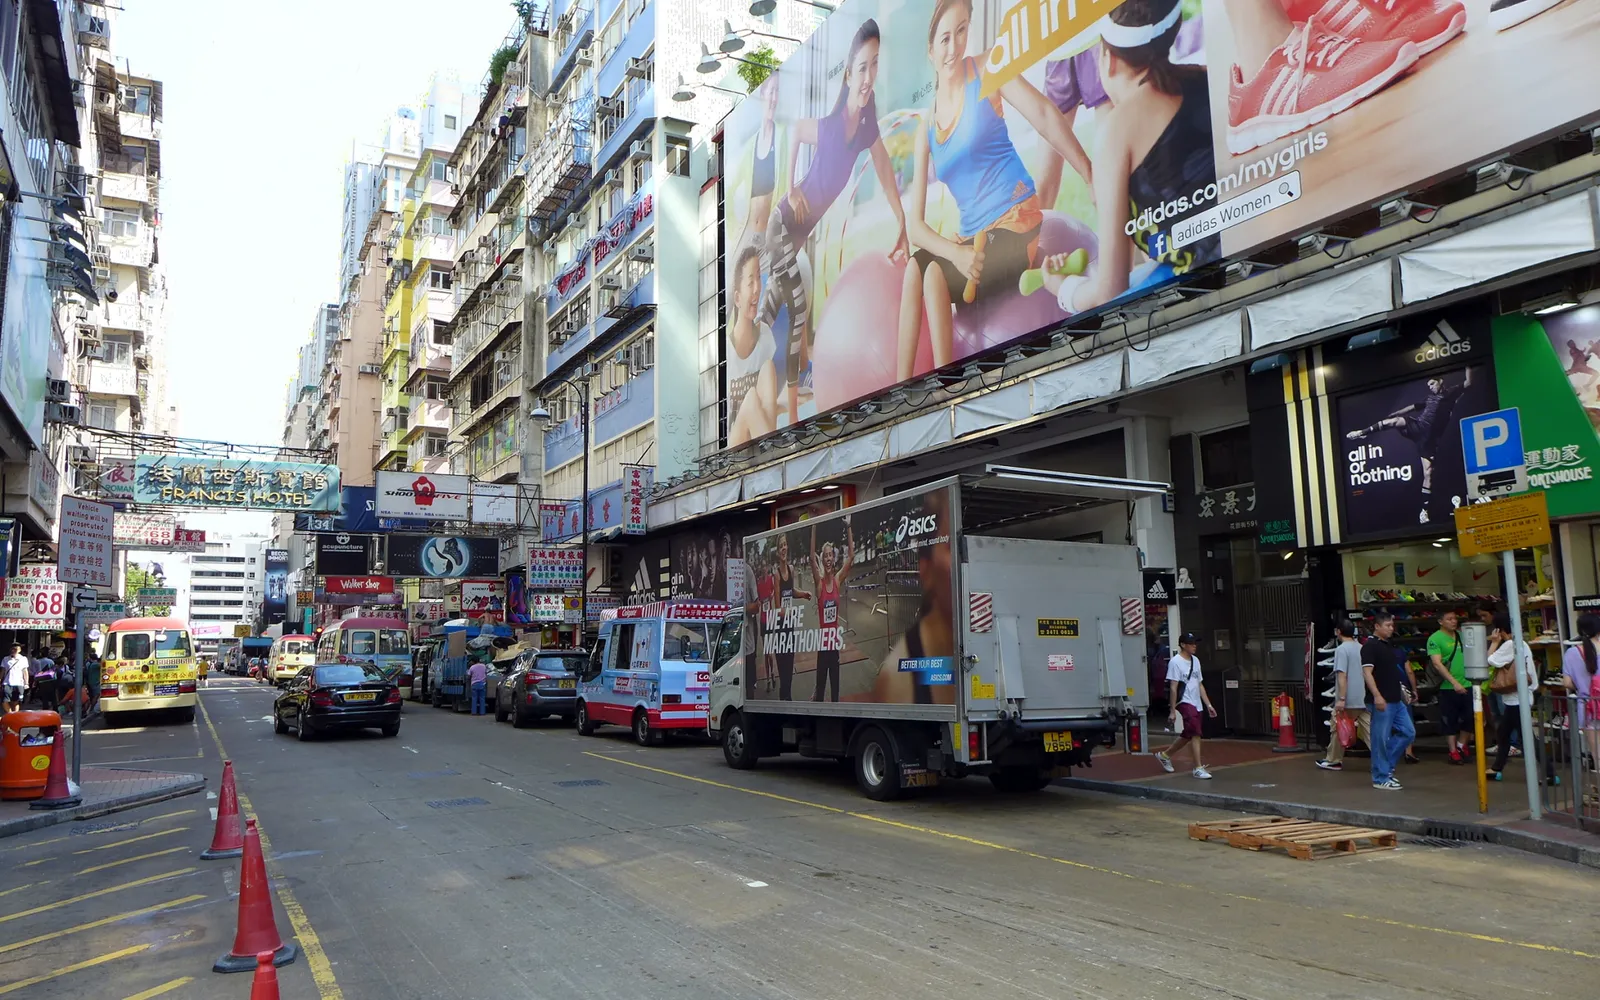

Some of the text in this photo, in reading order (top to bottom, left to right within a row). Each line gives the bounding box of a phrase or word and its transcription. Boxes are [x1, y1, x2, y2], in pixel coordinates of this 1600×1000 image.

[985, 5, 1030, 74] all
[1124, 131, 1328, 236] adidas.com/mygirls
[1177, 212, 1218, 243] adidas
[1219, 192, 1272, 224] Women
[1415, 339, 1471, 364] adidas
[1472, 417, 1509, 468] P
[1349, 444, 1383, 462] all in
[1524, 444, 1580, 467] 運動家
[1350, 460, 1366, 474] or
[1350, 464, 1412, 486] nothing
[1527, 466, 1592, 489] ORTSHOUSE
[161, 487, 313, 505] FRANCIS HOTEL
[66, 510, 88, 520] waiting
[90, 514, 101, 522] will
[77, 502, 100, 513] Vehicle
[62, 527, 111, 542] without warning
[70, 520, 104, 531] prosecuted
[908, 514, 936, 537] asics
[63, 566, 106, 581] 而不予警告
[340, 578, 365, 589] Walker
[627, 589, 656, 606] adidas
[1147, 591, 1169, 599] adidas
[764, 604, 805, 631] WE ARE
[763, 626, 846, 655] MARATHONERS.
[901, 659, 943, 669] BETTER YOUR BEST
[1051, 732, 1065, 742] LF
[1046, 741, 1072, 752] 7855
